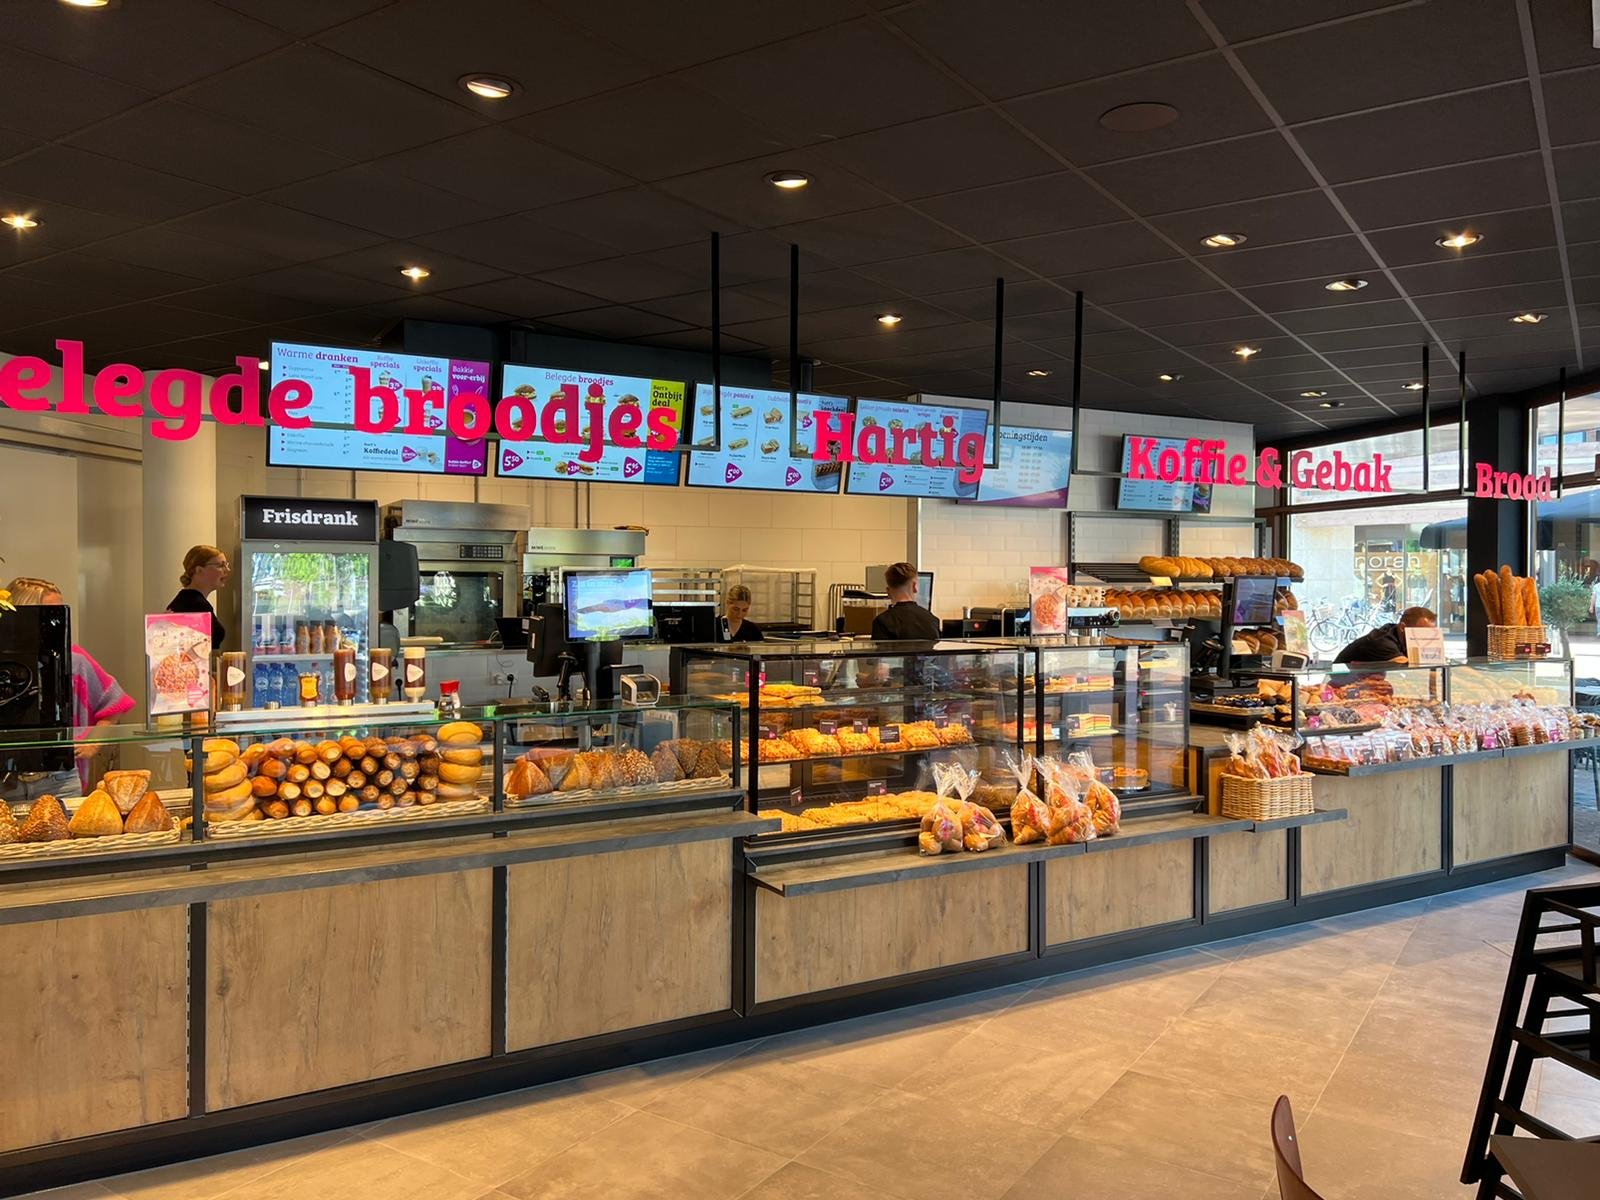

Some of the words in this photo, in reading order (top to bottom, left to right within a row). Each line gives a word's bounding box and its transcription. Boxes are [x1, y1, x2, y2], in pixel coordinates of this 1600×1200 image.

[277, 347, 314, 359] Warme
[316, 351, 358, 363] dranken
[545, 371, 577, 383] Belegde
[578, 376, 614, 387] broodjes
[0, 339, 313, 441] elegde
[349, 366, 678, 462] broodjes
[652, 390, 683, 402] Ontbijt
[652, 399, 670, 407] deal
[813, 411, 986, 484] Hartig
[1126, 437, 1248, 486] Koffie
[1256, 447, 1282, 490] &
[1292, 450, 1393, 493] Gebak
[1475, 463, 1552, 502] Brood
[262, 508, 359, 526] Frisdrank
